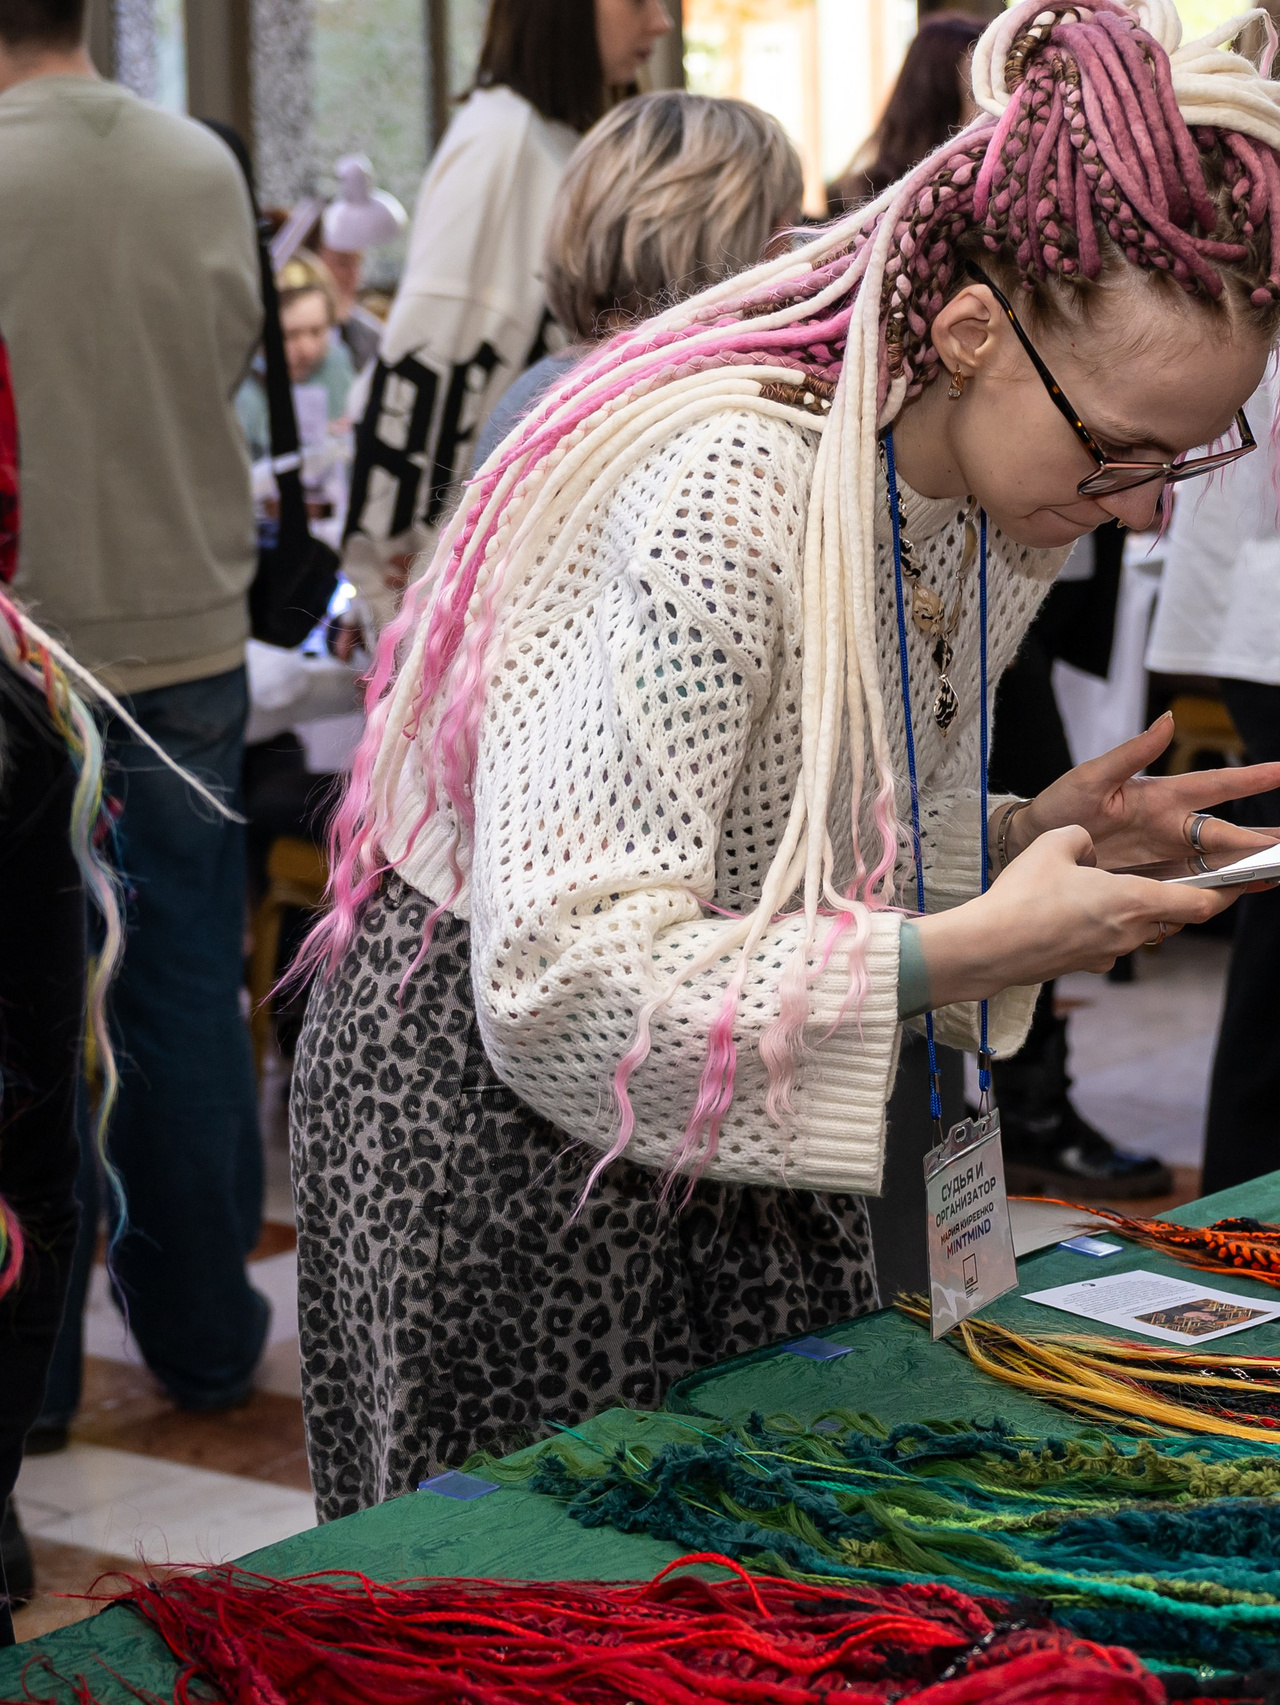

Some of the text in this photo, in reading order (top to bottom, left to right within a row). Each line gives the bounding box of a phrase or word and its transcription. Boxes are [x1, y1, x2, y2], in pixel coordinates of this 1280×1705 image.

[935, 1176, 996, 1228] ОРГАНИЗАТОР
[941, 1161, 984, 1202] СУДЬЯ И
[940, 1201, 994, 1246] МАРИЯ КИРЕЕНКО
[946, 1218, 992, 1259] MINTMIND
